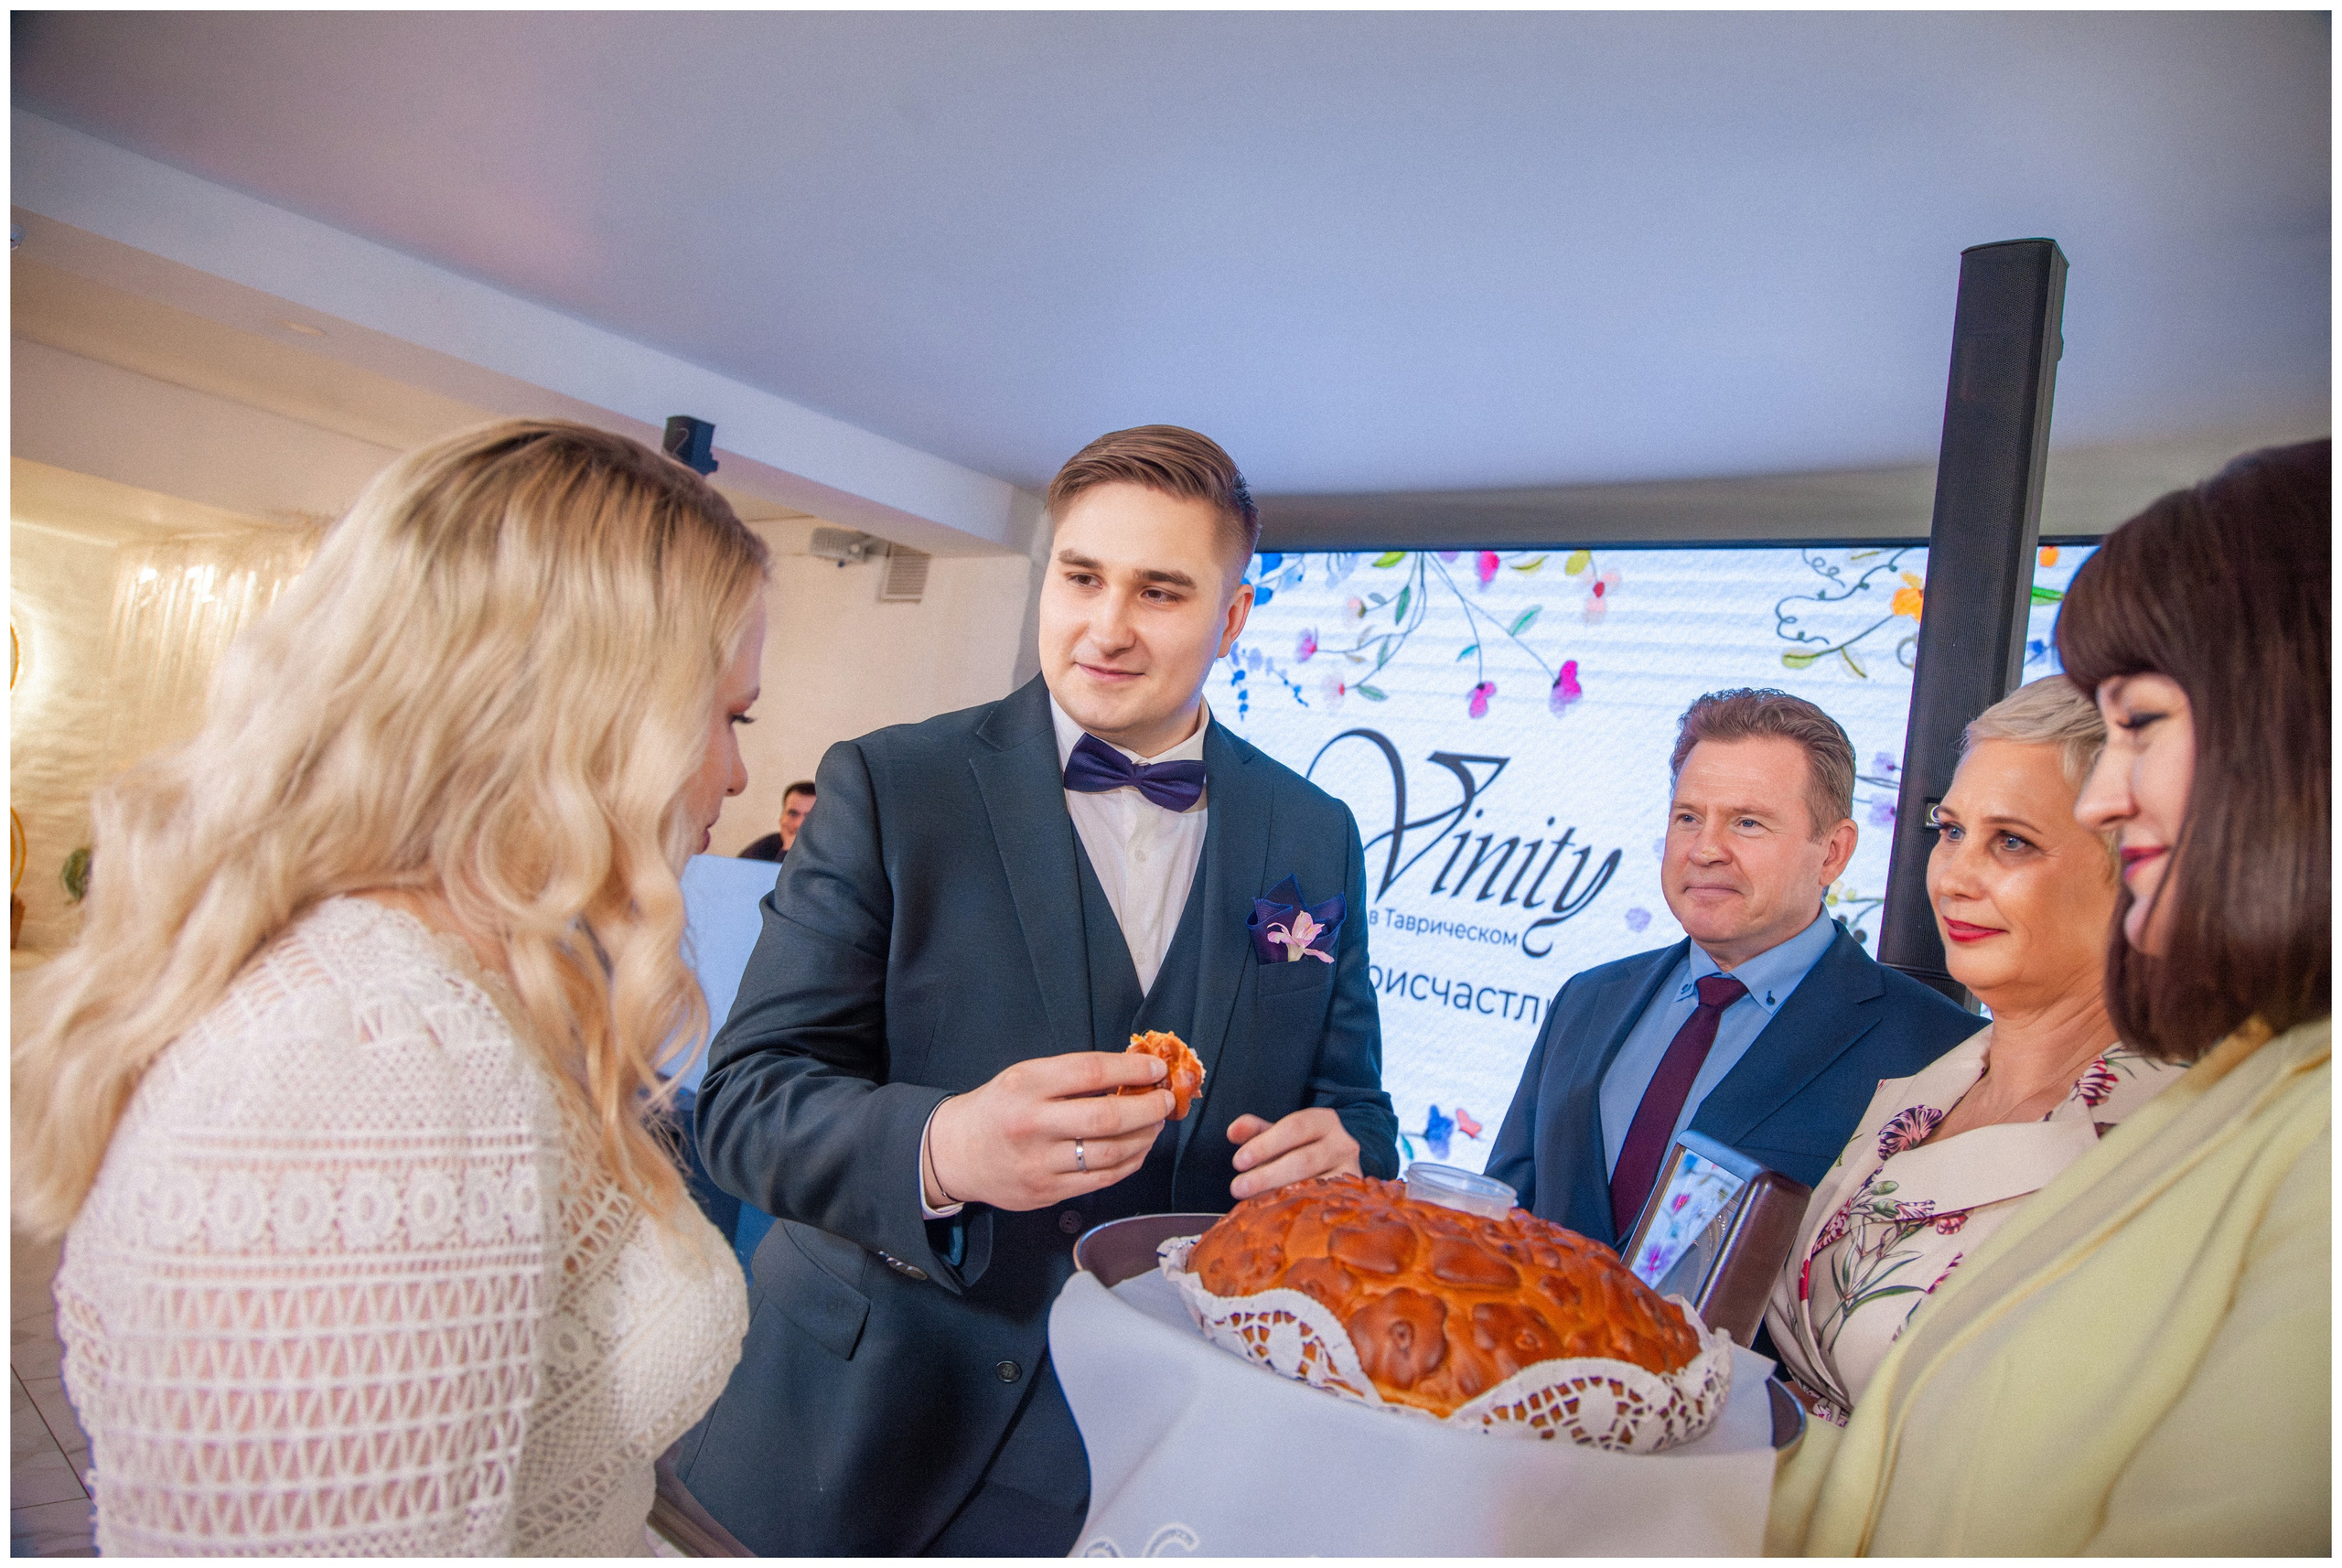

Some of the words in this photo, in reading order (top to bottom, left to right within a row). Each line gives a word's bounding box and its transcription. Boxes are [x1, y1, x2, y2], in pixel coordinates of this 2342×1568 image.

[1305, 727, 1623, 958] Vinity
[1369, 909, 1379, 926] в
[1385, 908, 1519, 947] Таврическом
[1369, 964, 1551, 1025] исчастл
